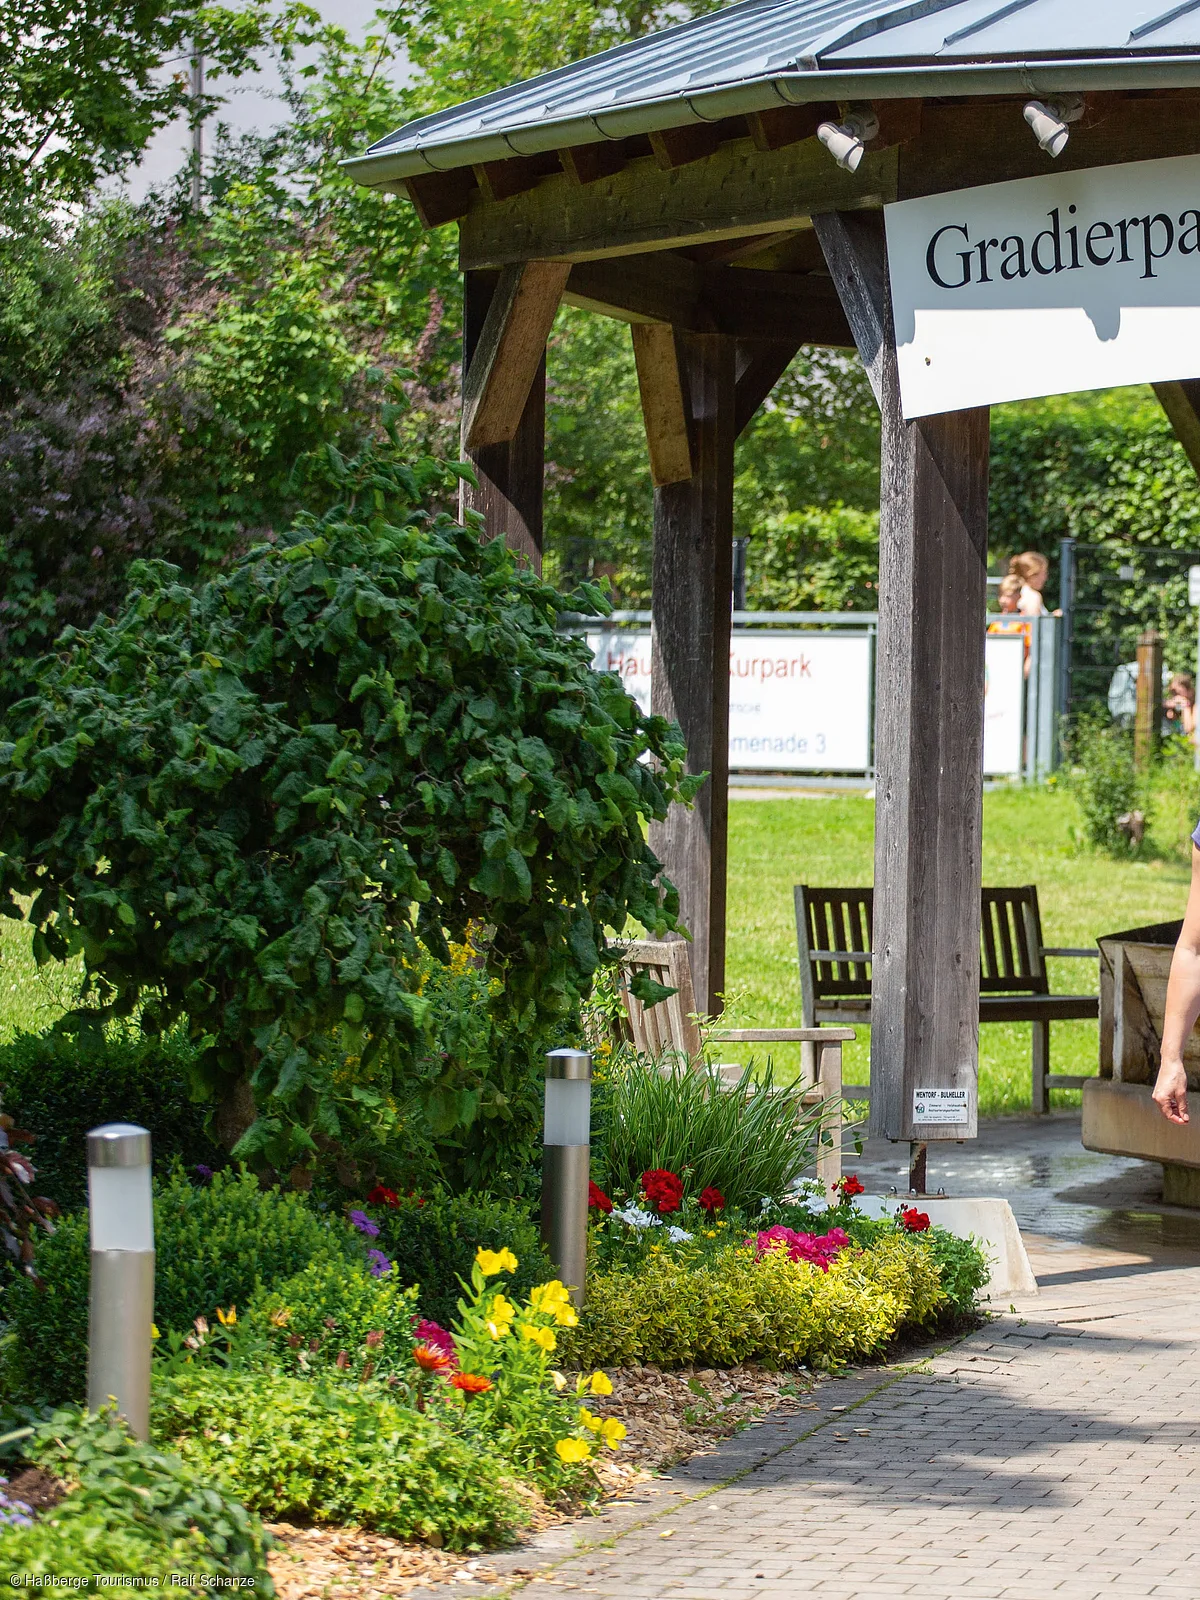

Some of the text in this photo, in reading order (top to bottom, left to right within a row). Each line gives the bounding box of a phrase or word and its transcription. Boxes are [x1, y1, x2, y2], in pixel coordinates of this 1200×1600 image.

[606, 650, 652, 677] Hau
[730, 732, 827, 755] menade 3
